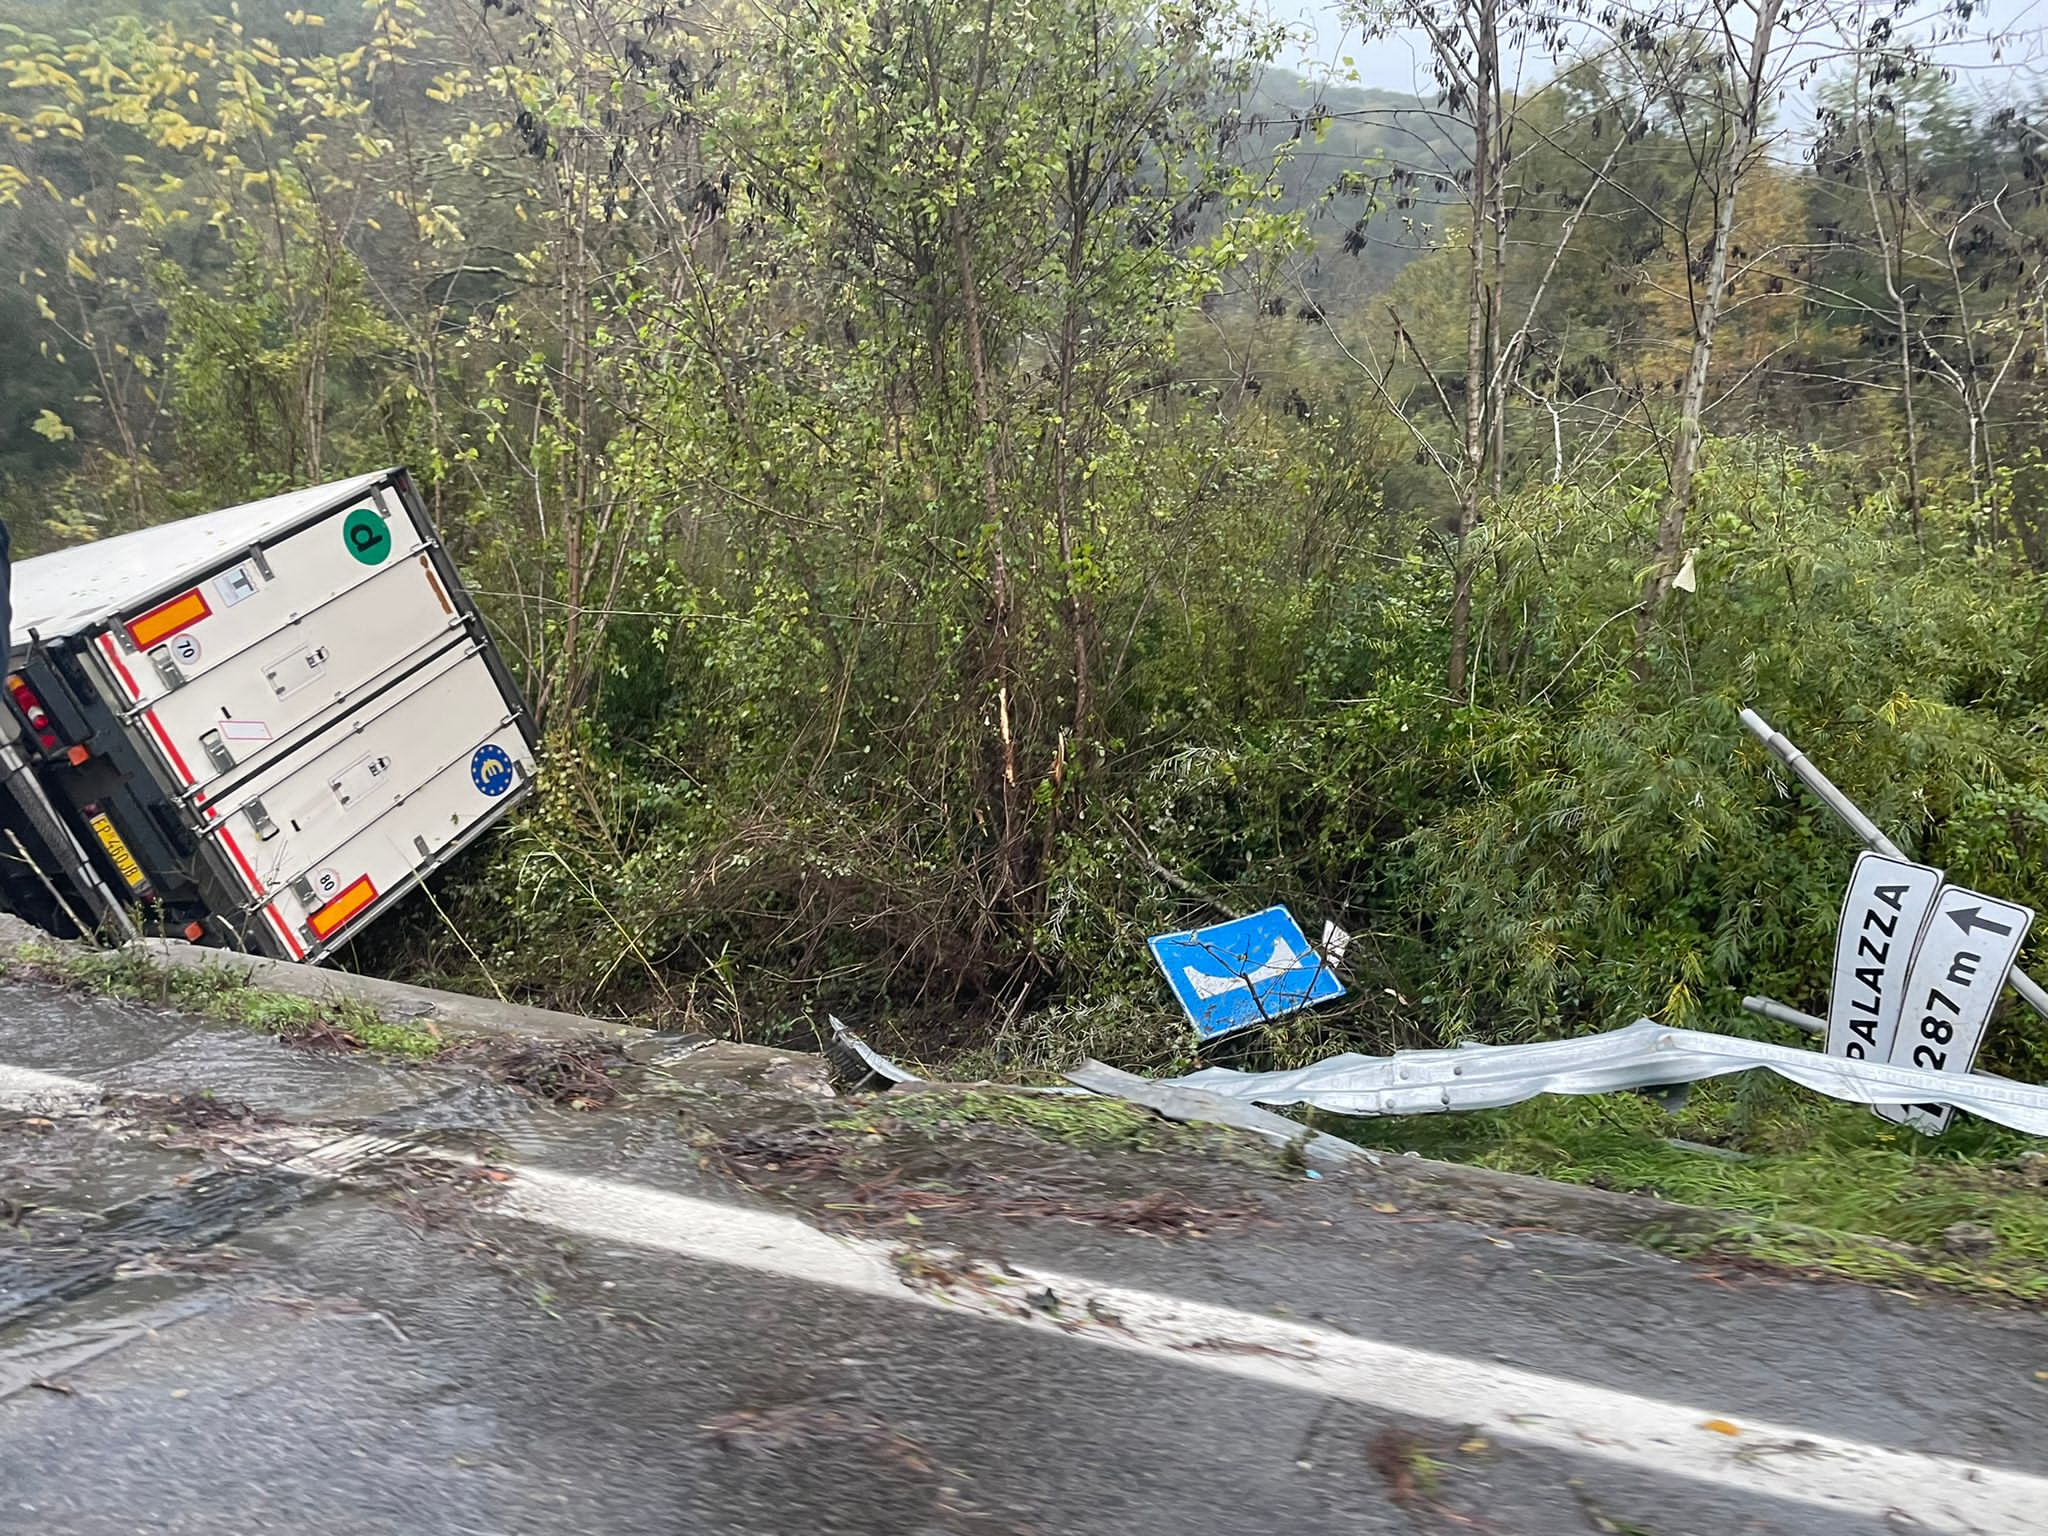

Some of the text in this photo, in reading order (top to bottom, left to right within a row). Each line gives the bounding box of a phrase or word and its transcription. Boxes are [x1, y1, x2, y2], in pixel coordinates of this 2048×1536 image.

[177, 640, 195, 659] 70
[319, 873, 335, 892] 80
[1847, 885, 1910, 1060] PALAZZA
[1947, 951, 1981, 986] m
